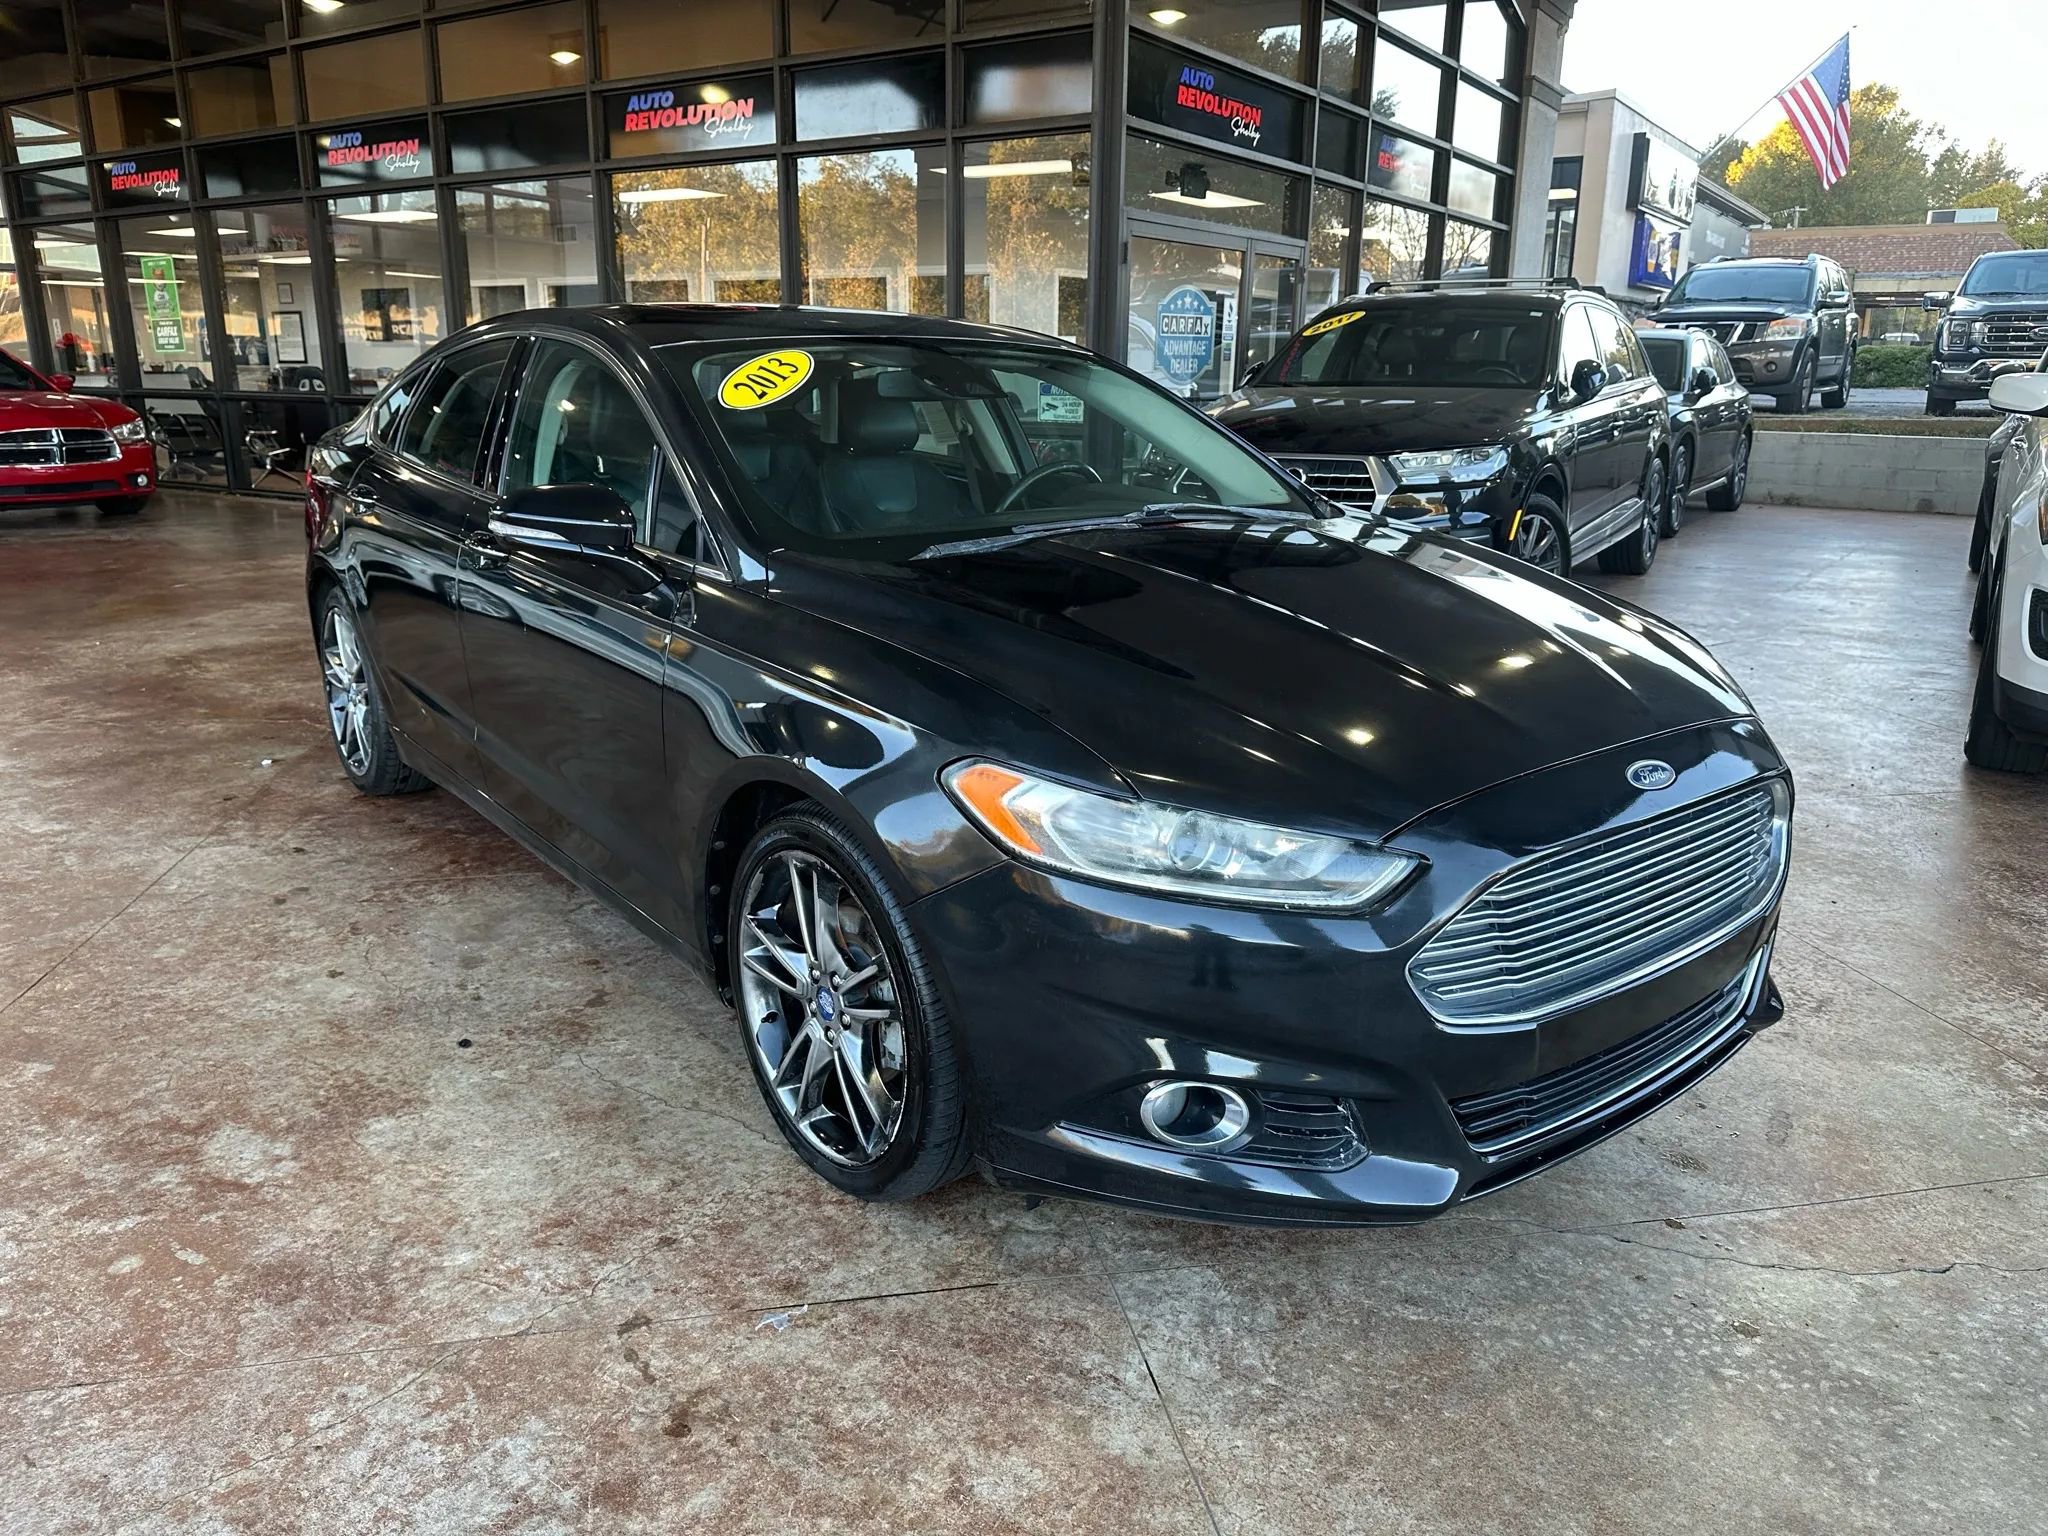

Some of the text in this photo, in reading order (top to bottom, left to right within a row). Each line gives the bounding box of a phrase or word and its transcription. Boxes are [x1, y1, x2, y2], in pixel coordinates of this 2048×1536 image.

[1180, 67, 1215, 91] AUTO
[627, 90, 674, 112] AUTO
[1177, 84, 1262, 127] REVOLUTION
[625, 98, 754, 132] REVOLUTION
[704, 114, 755, 140] Shelby
[1231, 116, 1261, 147] Shelby
[329, 132, 363, 149] AUTO
[327, 138, 419, 167] REVOLUTION
[385, 150, 421, 174] Shelby
[111, 168, 179, 191] REVOLUTION
[112, 162, 136, 176] AUTO
[153, 179, 181, 198] Shelby
[157, 326, 178, 337] CARFAX
[1161, 315, 1210, 336] CARFAX
[1311, 312, 1357, 334] 2017
[1163, 341, 1206, 356] ADVANTAGE
[1170, 359, 1198, 374] DEALER
[733, 358, 799, 401] 2013
[1637, 766, 1666, 784] Ford
